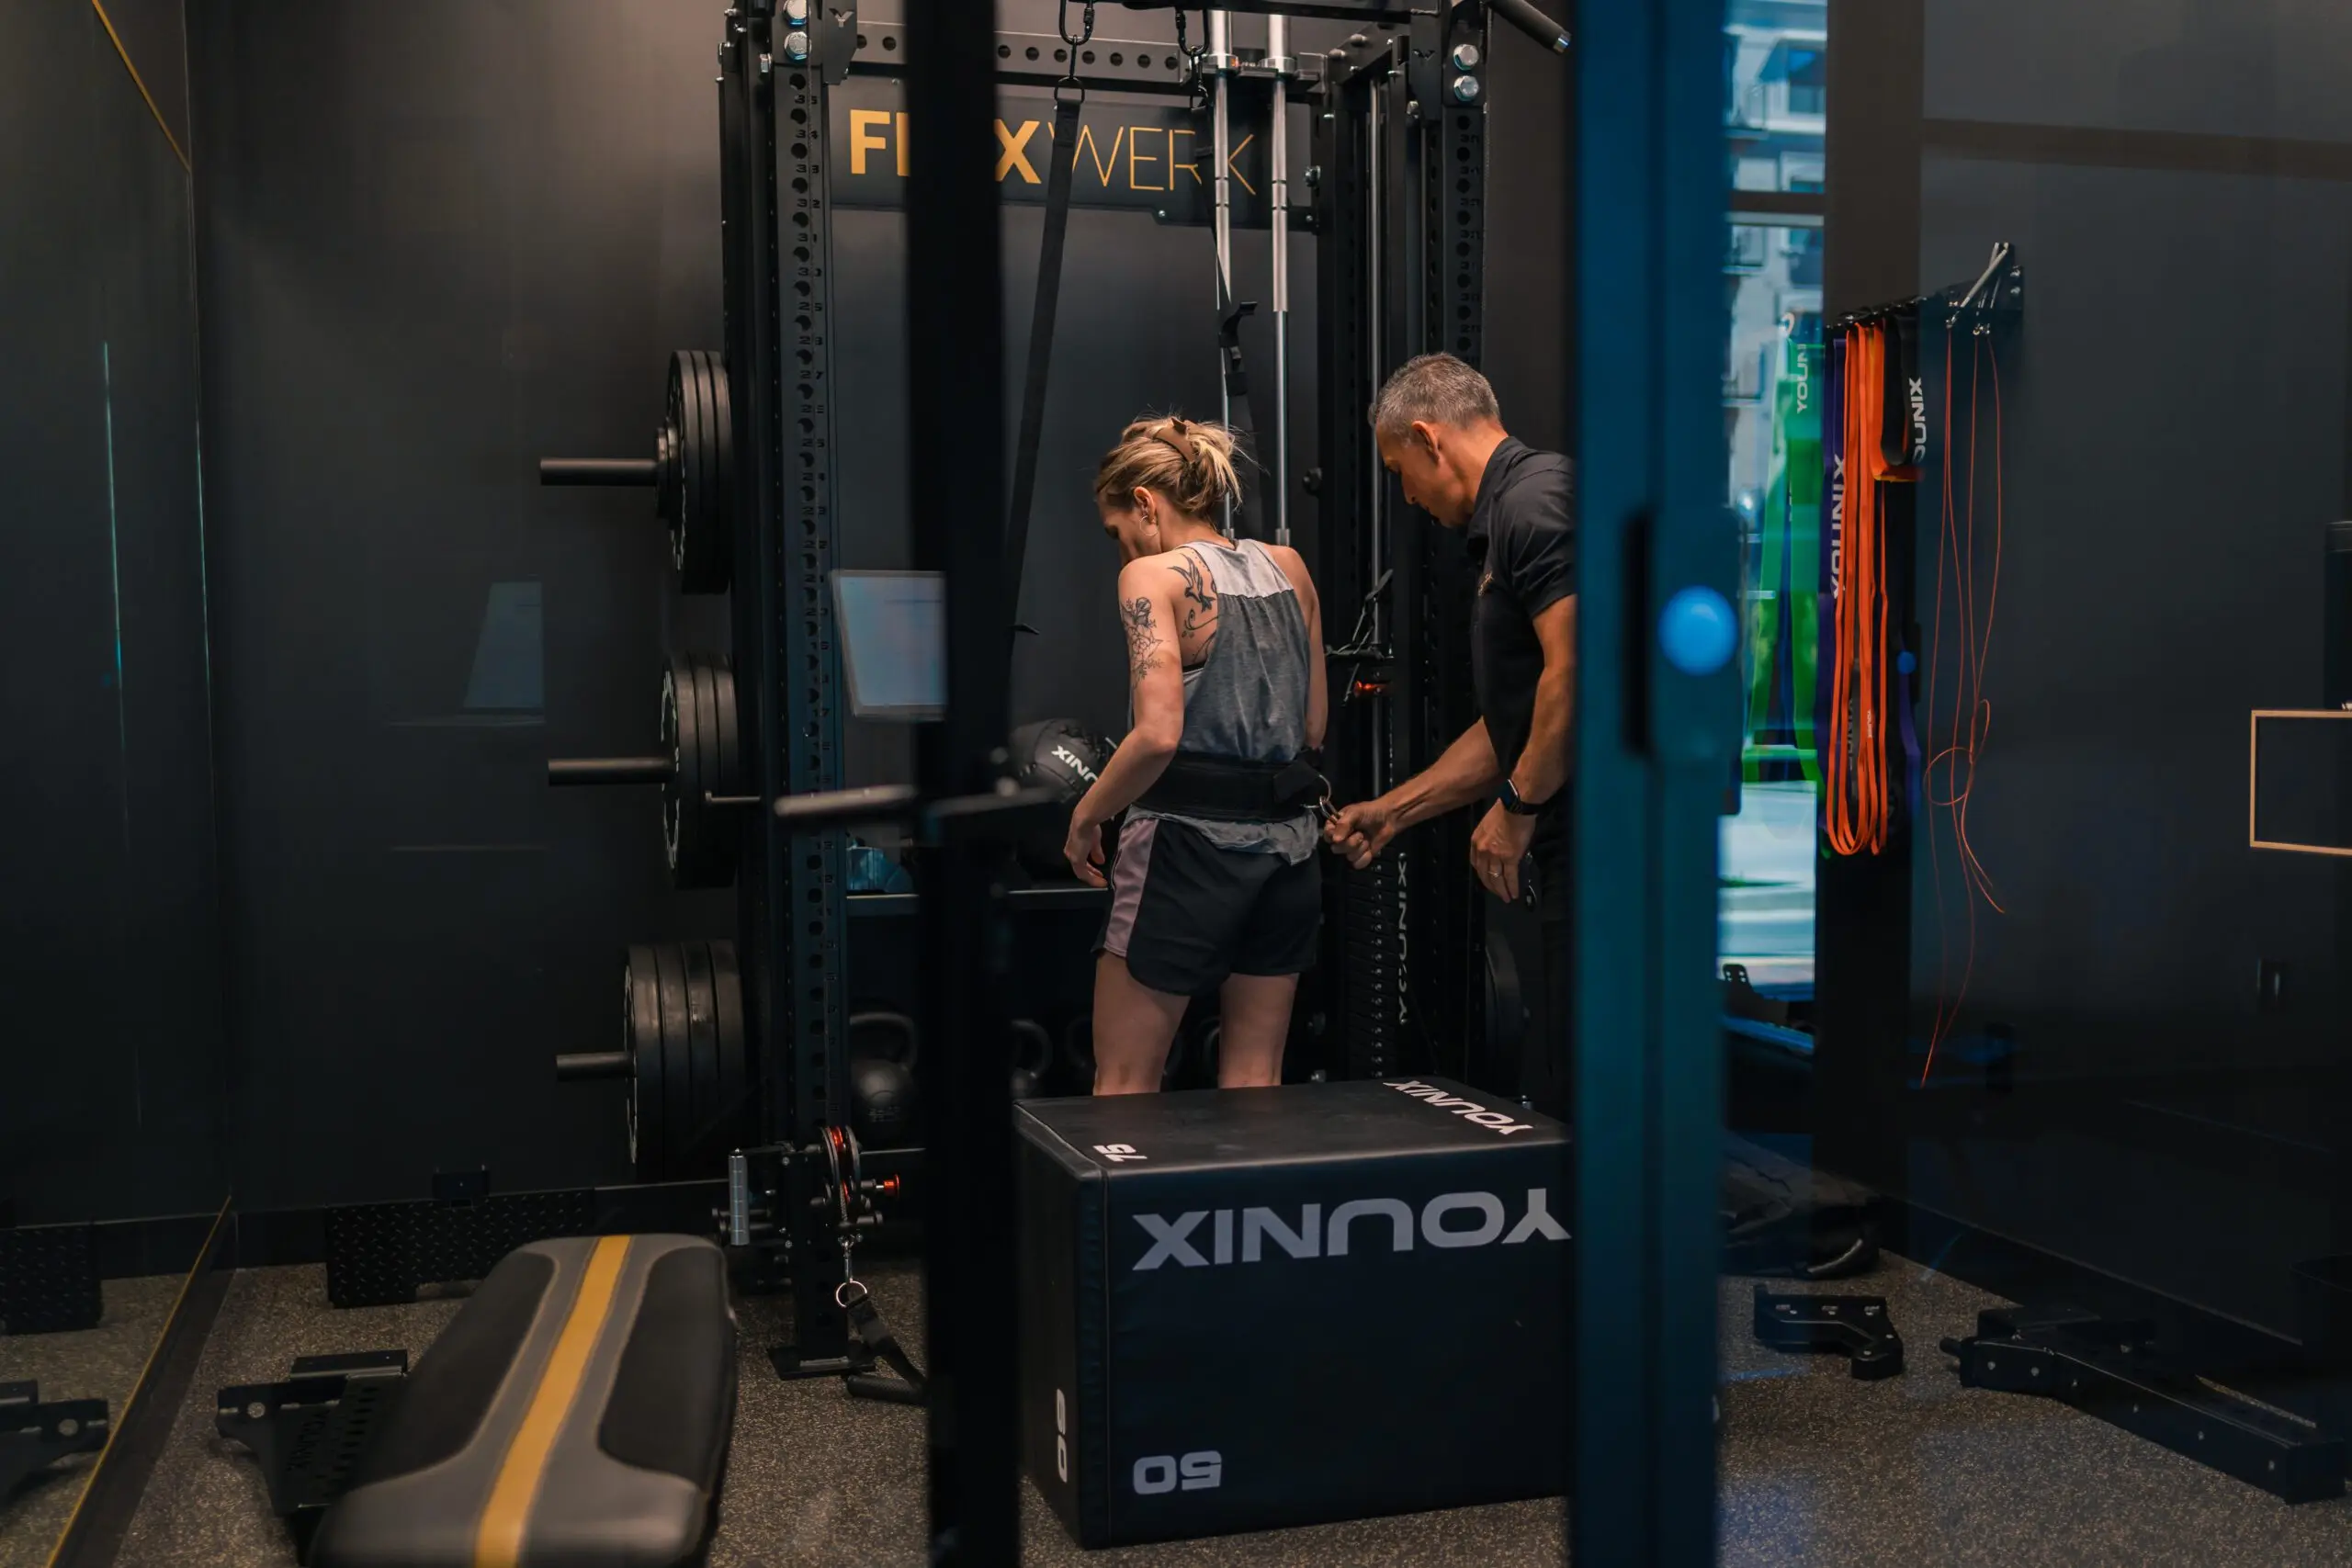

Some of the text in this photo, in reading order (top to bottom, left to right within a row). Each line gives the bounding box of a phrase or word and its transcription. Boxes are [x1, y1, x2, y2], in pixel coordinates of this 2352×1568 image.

[1797, 344, 1808, 413] YOUNI
[1384, 1080, 1534, 1135] YOUNIX
[1092, 1144, 1148, 1162] 75
[1132, 1188, 1572, 1271] YOUNIX
[1133, 1450, 1222, 1495] 50
